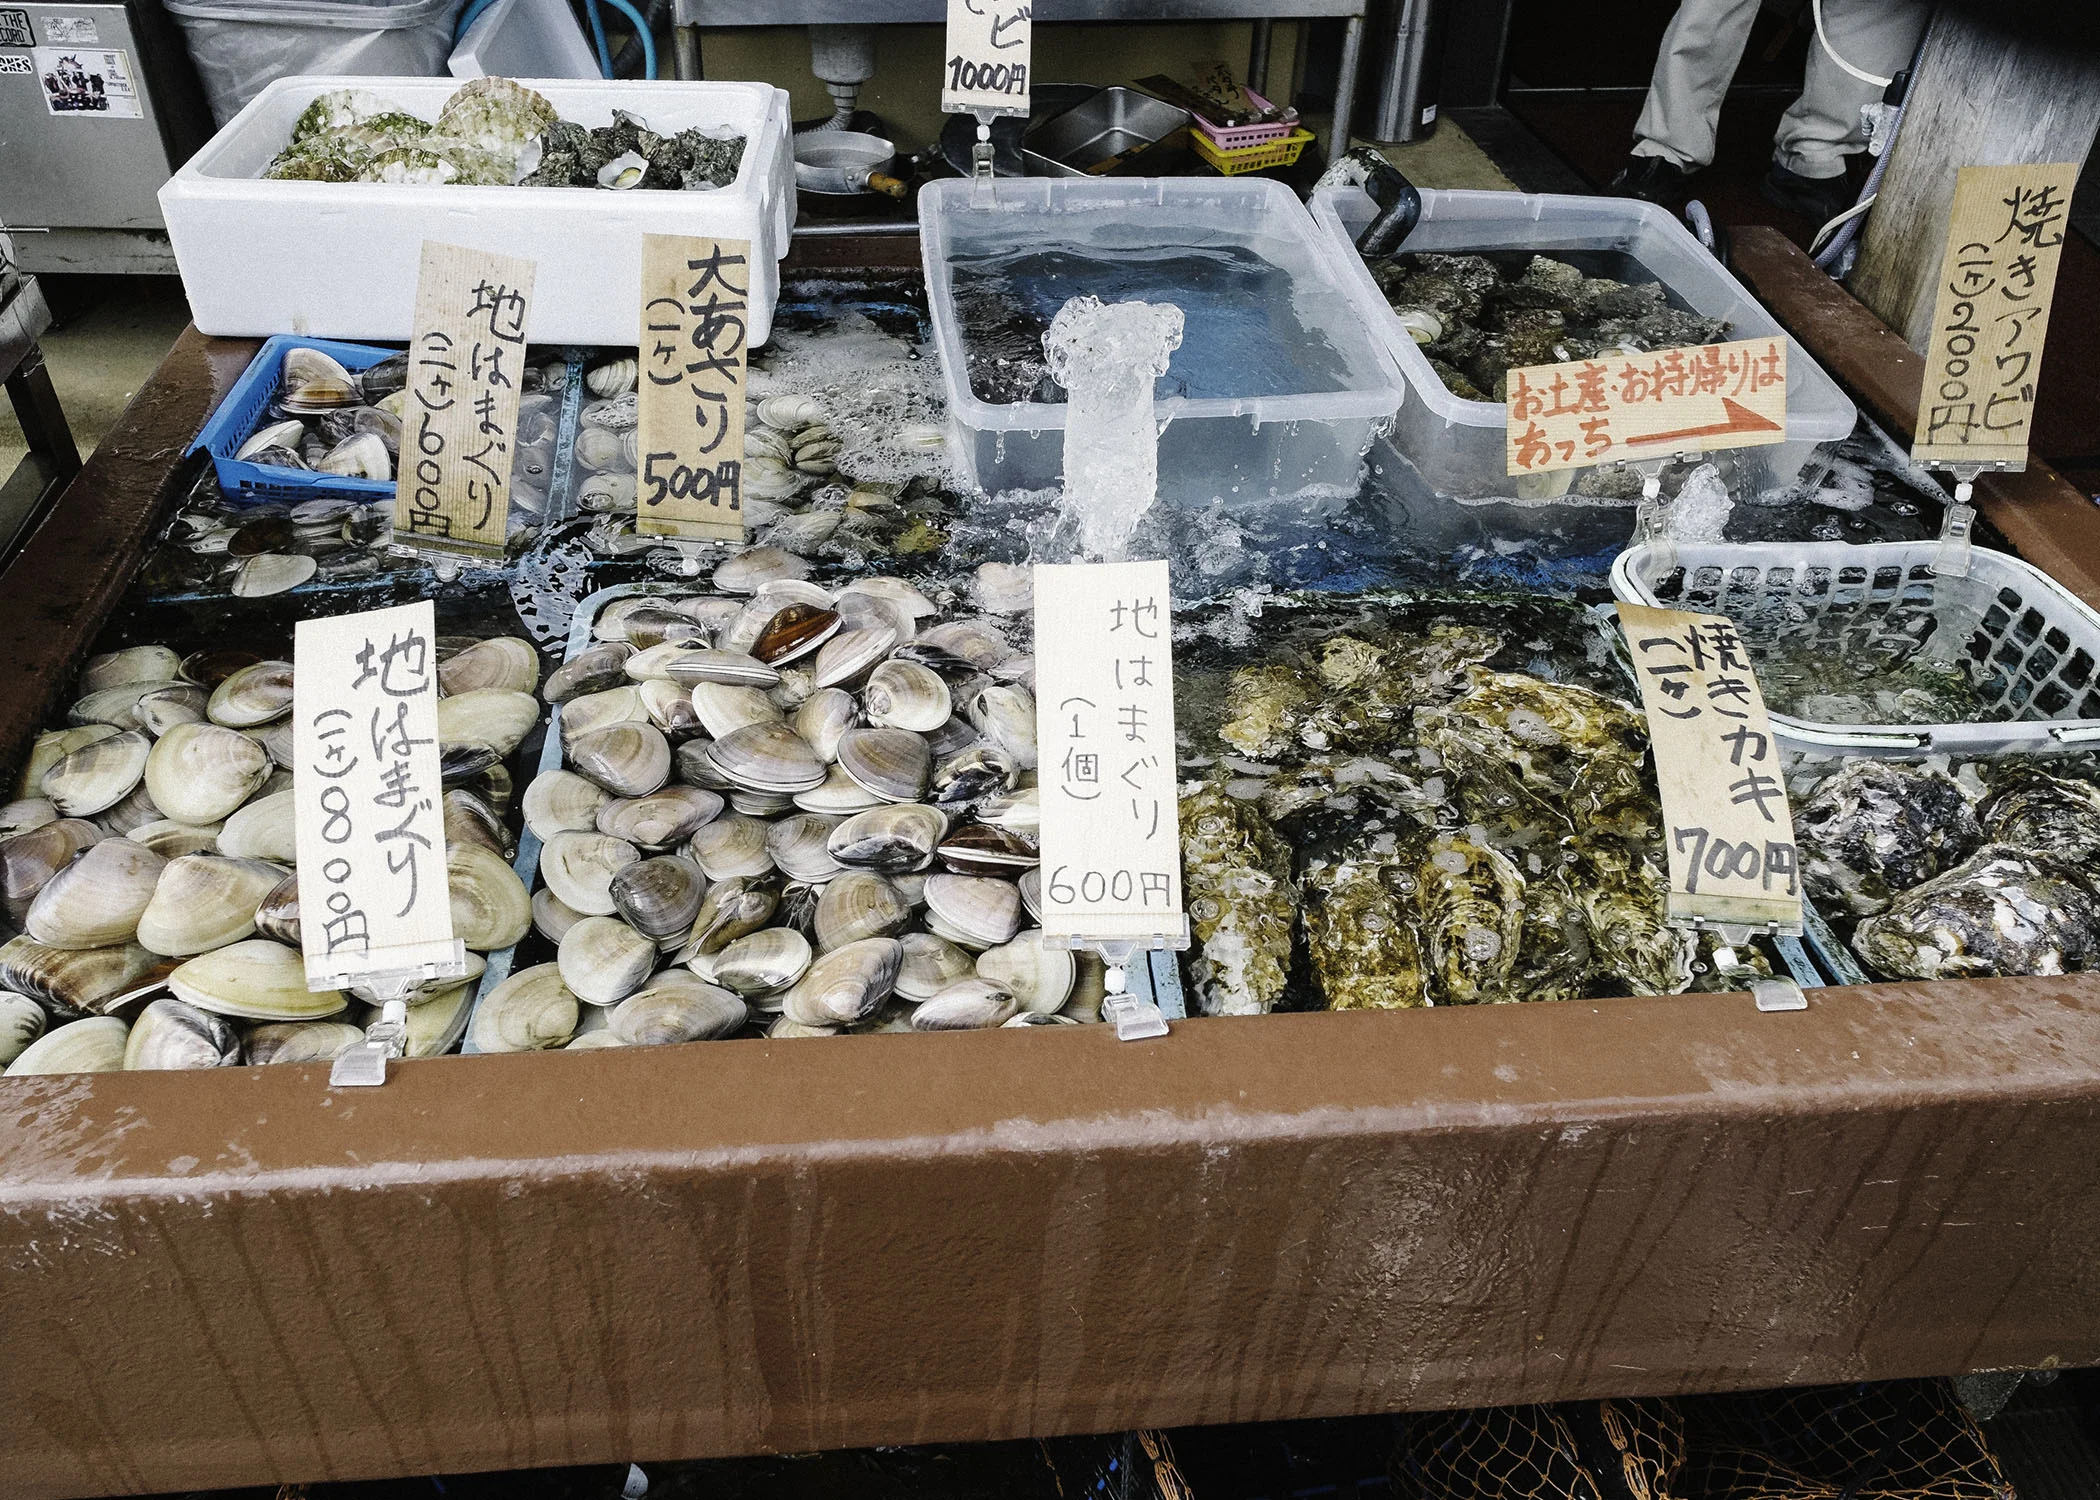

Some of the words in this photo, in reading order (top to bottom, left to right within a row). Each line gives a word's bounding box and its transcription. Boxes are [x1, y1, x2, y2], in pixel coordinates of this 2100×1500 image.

[0, 27, 25, 42] CORD
[1, 13, 27, 31] THE
[990, 0, 1032, 49] ビ
[948, 55, 1027, 95] 1000円
[1983, 185, 2065, 431] 焼きアワビ
[686, 243, 748, 454] 大あさり
[462, 279, 526, 530] 地はまぐり
[1514, 416, 1613, 469] あっち
[643, 451, 741, 511] 500円
[1109, 597, 1159, 841] 地はまぐり
[1684, 622, 1784, 824] 焼きカキ
[352, 628, 434, 918] 地はまぐり
[1048, 865, 1171, 906] 600円
[1673, 825, 1798, 897] 700円
